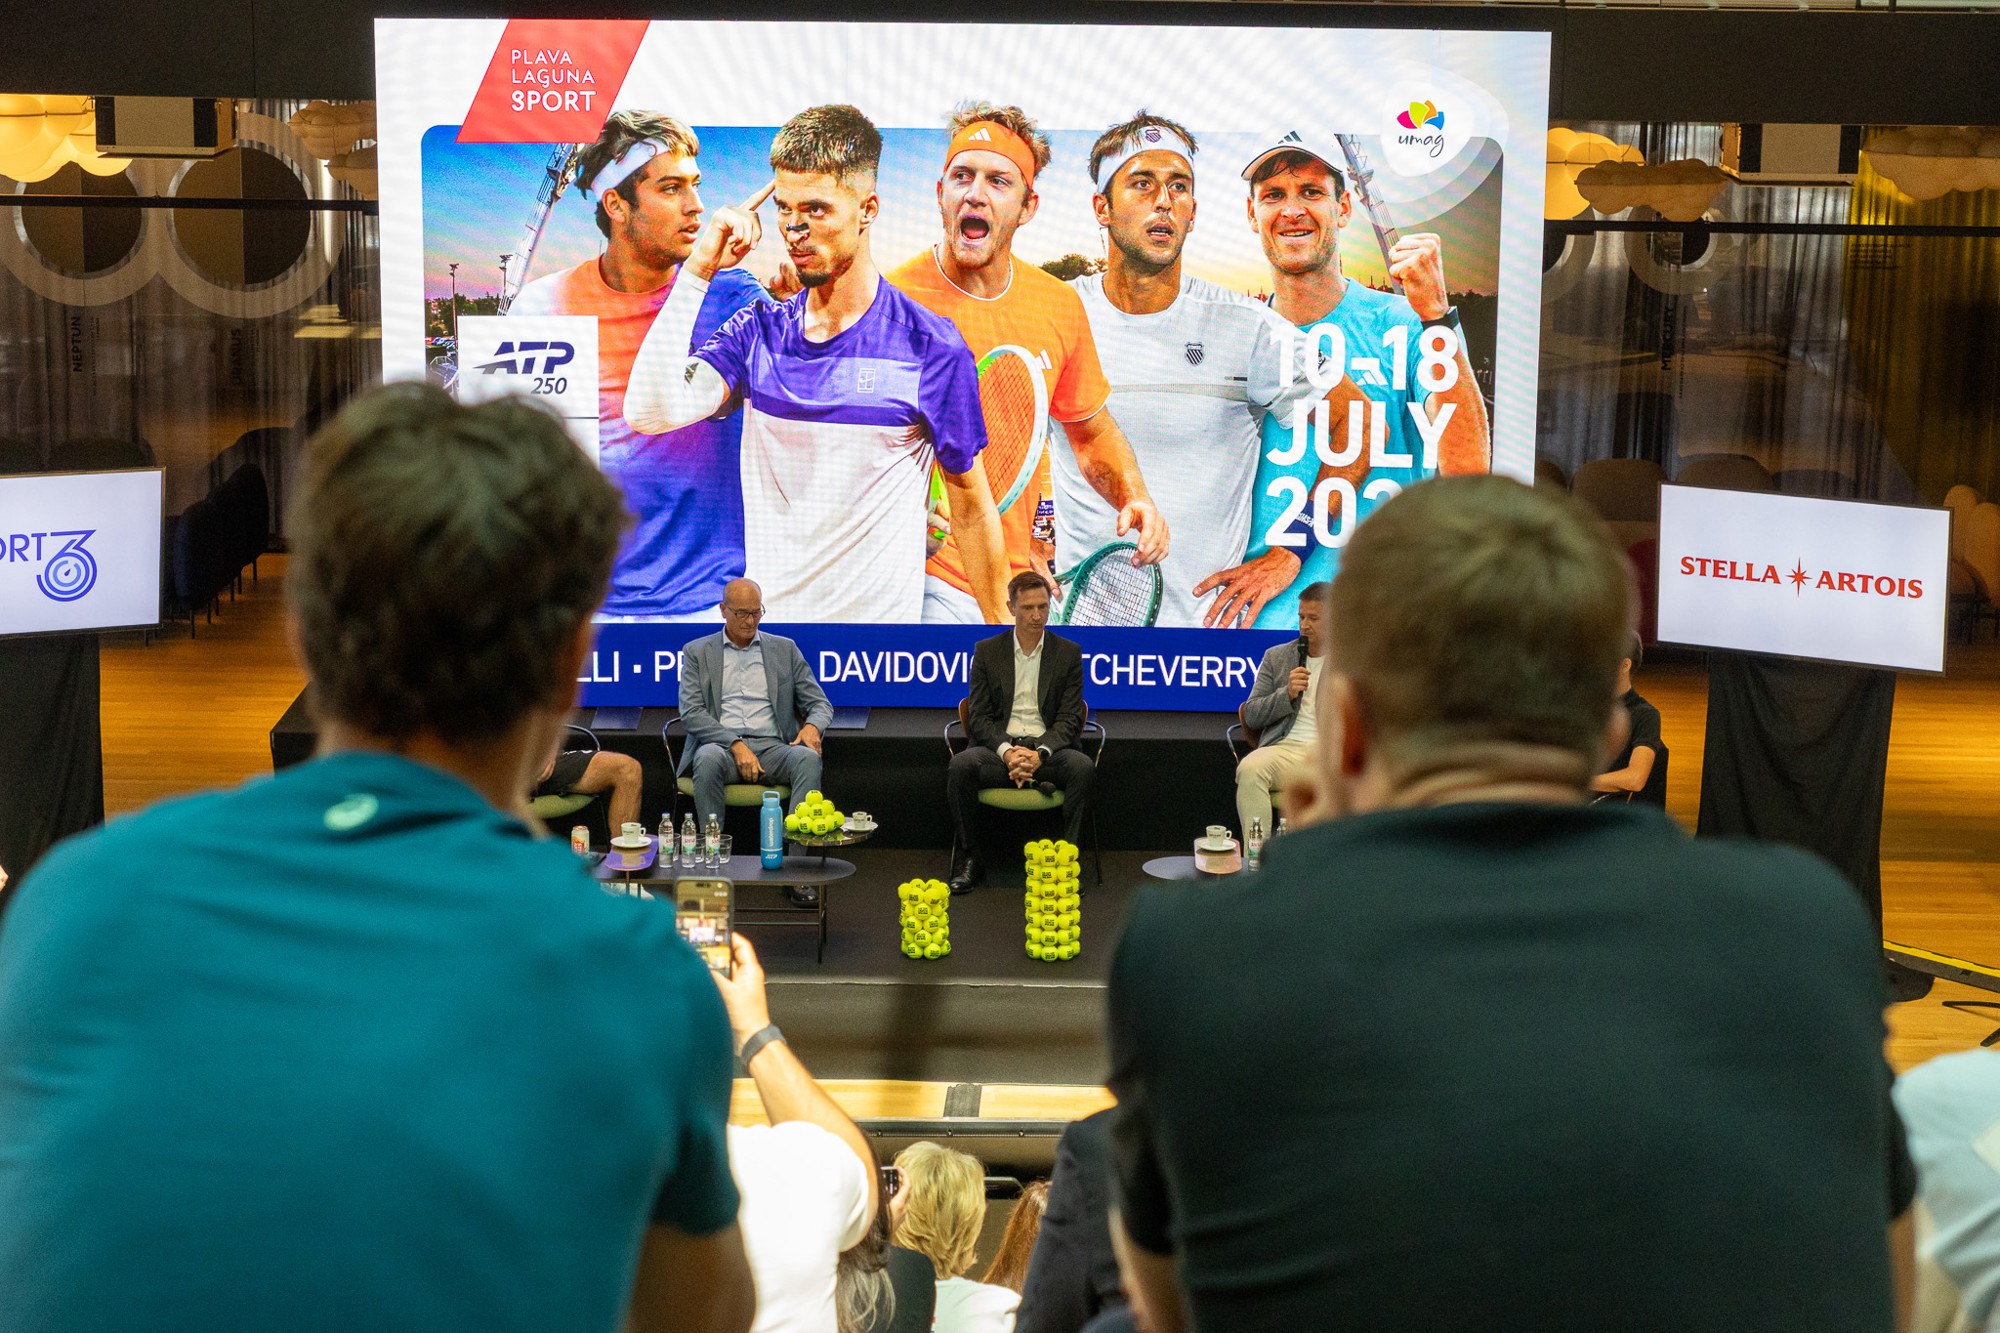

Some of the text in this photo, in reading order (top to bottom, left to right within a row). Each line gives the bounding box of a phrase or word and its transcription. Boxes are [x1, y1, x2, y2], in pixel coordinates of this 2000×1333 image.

[511, 49, 573, 65] PLAVA
[511, 68, 595, 88] LAGUNA
[511, 90, 596, 112] SPORT
[1398, 134, 1444, 158] umag
[71, 316, 82, 373] NEPTUN
[473, 341, 575, 374] ATP
[1269, 322, 1459, 393] 10-18
[530, 377, 567, 395] 250
[1265, 400, 1458, 469] JULY
[1680, 556, 1923, 599] STELLA ARTOIS
[819, 651, 975, 683] DAVIDOVI
[1081, 653, 1263, 688] CHEVERRY
